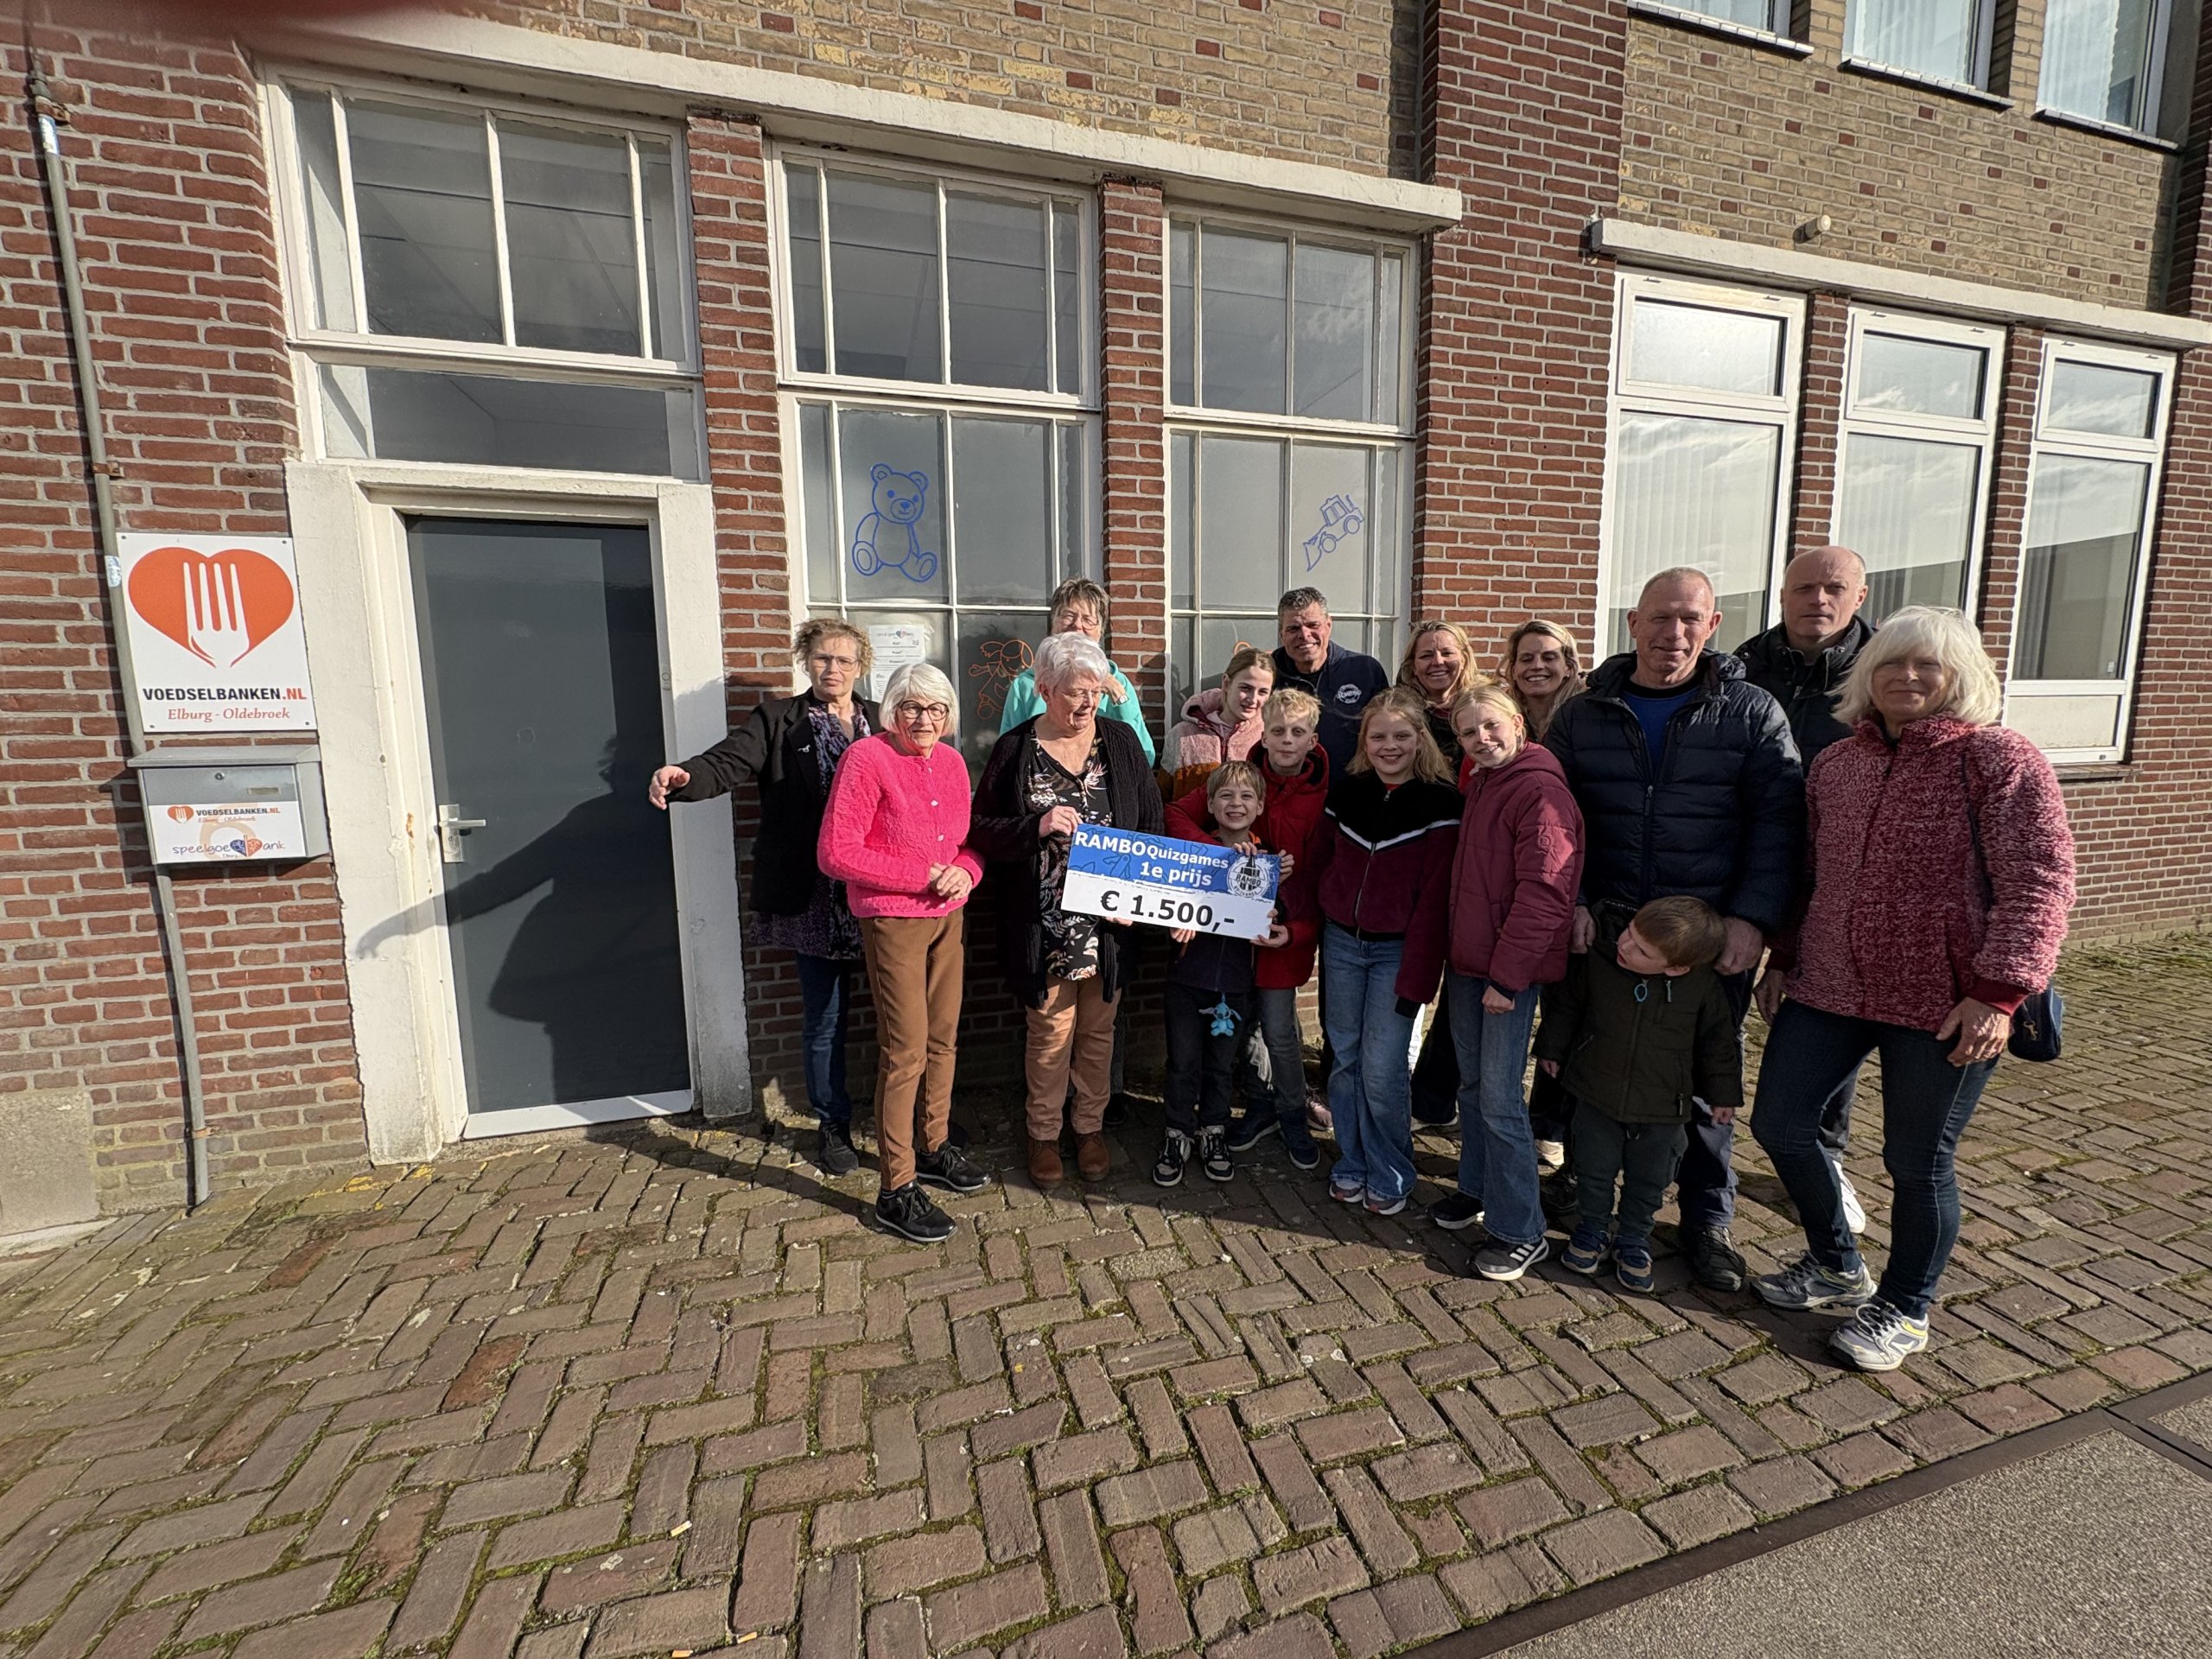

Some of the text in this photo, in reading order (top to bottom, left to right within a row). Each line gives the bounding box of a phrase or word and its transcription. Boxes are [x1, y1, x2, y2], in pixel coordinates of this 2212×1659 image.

[143, 688, 307, 701] VOEDSELBANKEN.NL
[168, 709, 213, 722] Elburg
[223, 708, 290, 719] Oldebroek
[196, 807, 281, 817] VOEDSELBANKEN.NL
[1140, 861, 1212, 888] 1e prijs
[1236, 874, 1262, 887] RAMBO
[1100, 890, 1235, 932] € 1.500,-
